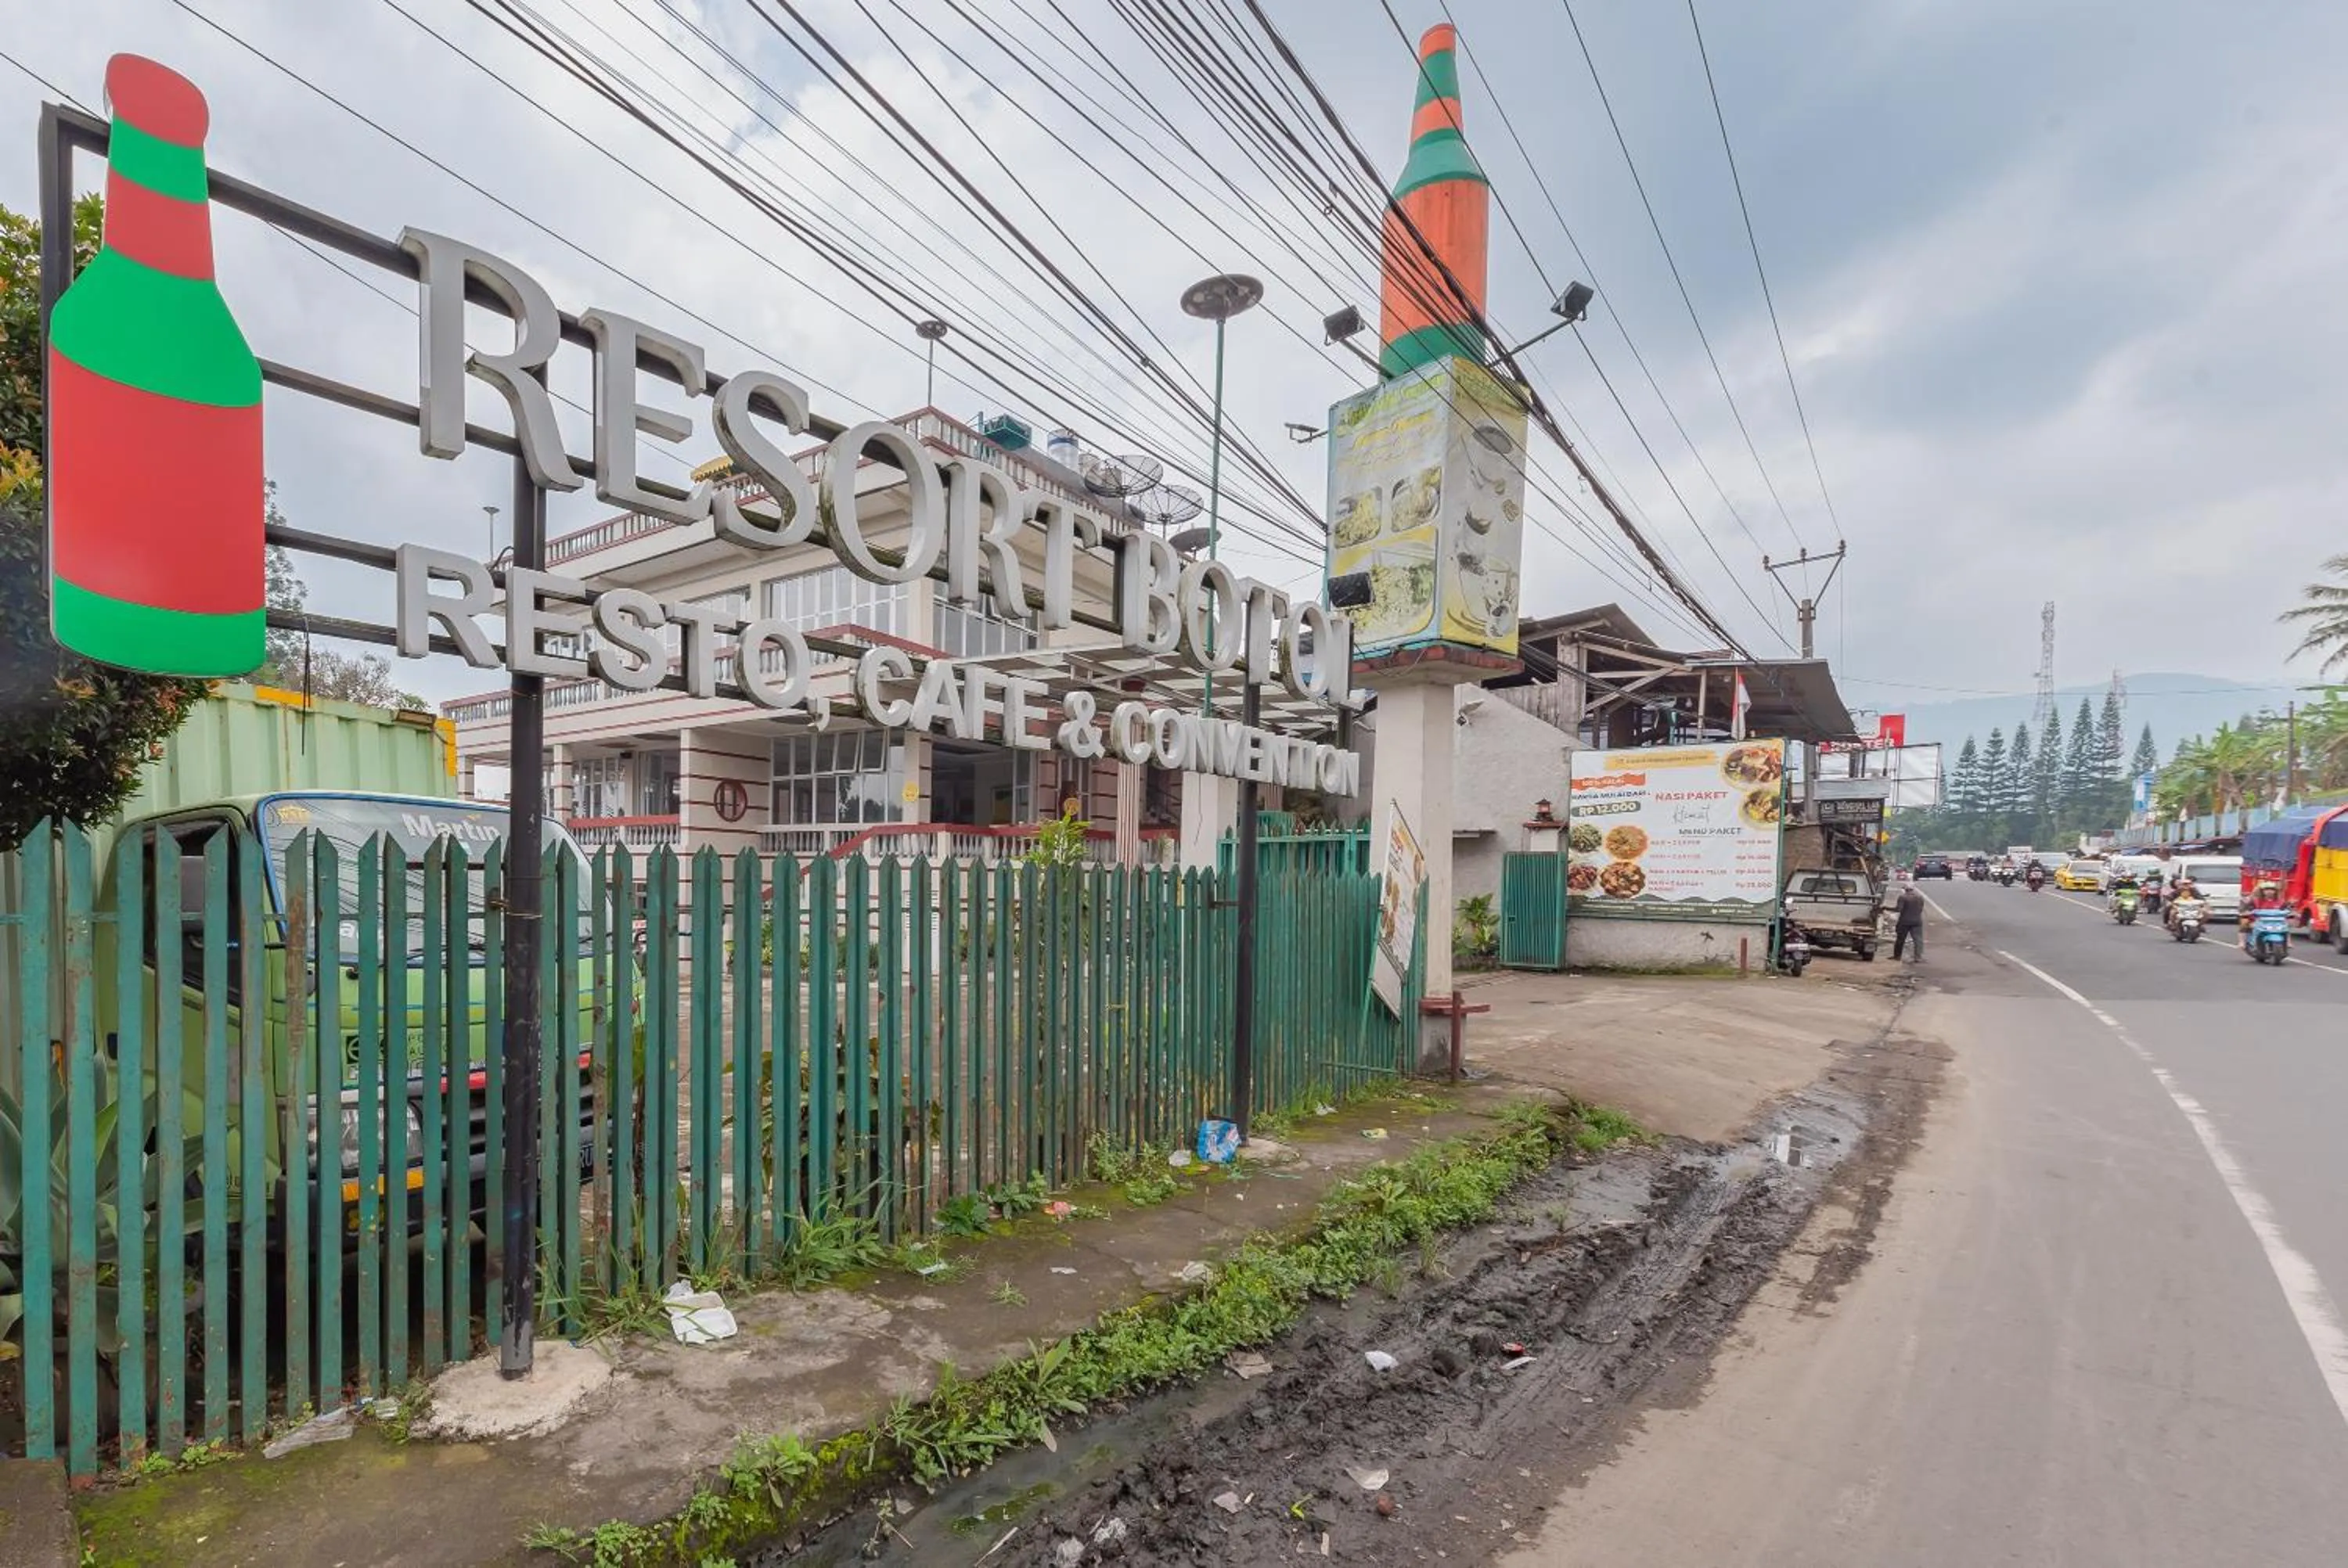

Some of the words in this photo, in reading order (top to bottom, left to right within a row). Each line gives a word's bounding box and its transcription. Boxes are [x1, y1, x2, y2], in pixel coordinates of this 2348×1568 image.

[396, 225, 1102, 629] RESORT
[1122, 528, 1365, 710] BOTOL
[396, 542, 830, 732] RESTO,
[854, 646, 1052, 751] CAFE
[1058, 691, 1106, 759] &
[1110, 701, 1360, 798] CONVENTION
[401, 813, 502, 842] Martin
[1687, 790, 1728, 800] PAKET
